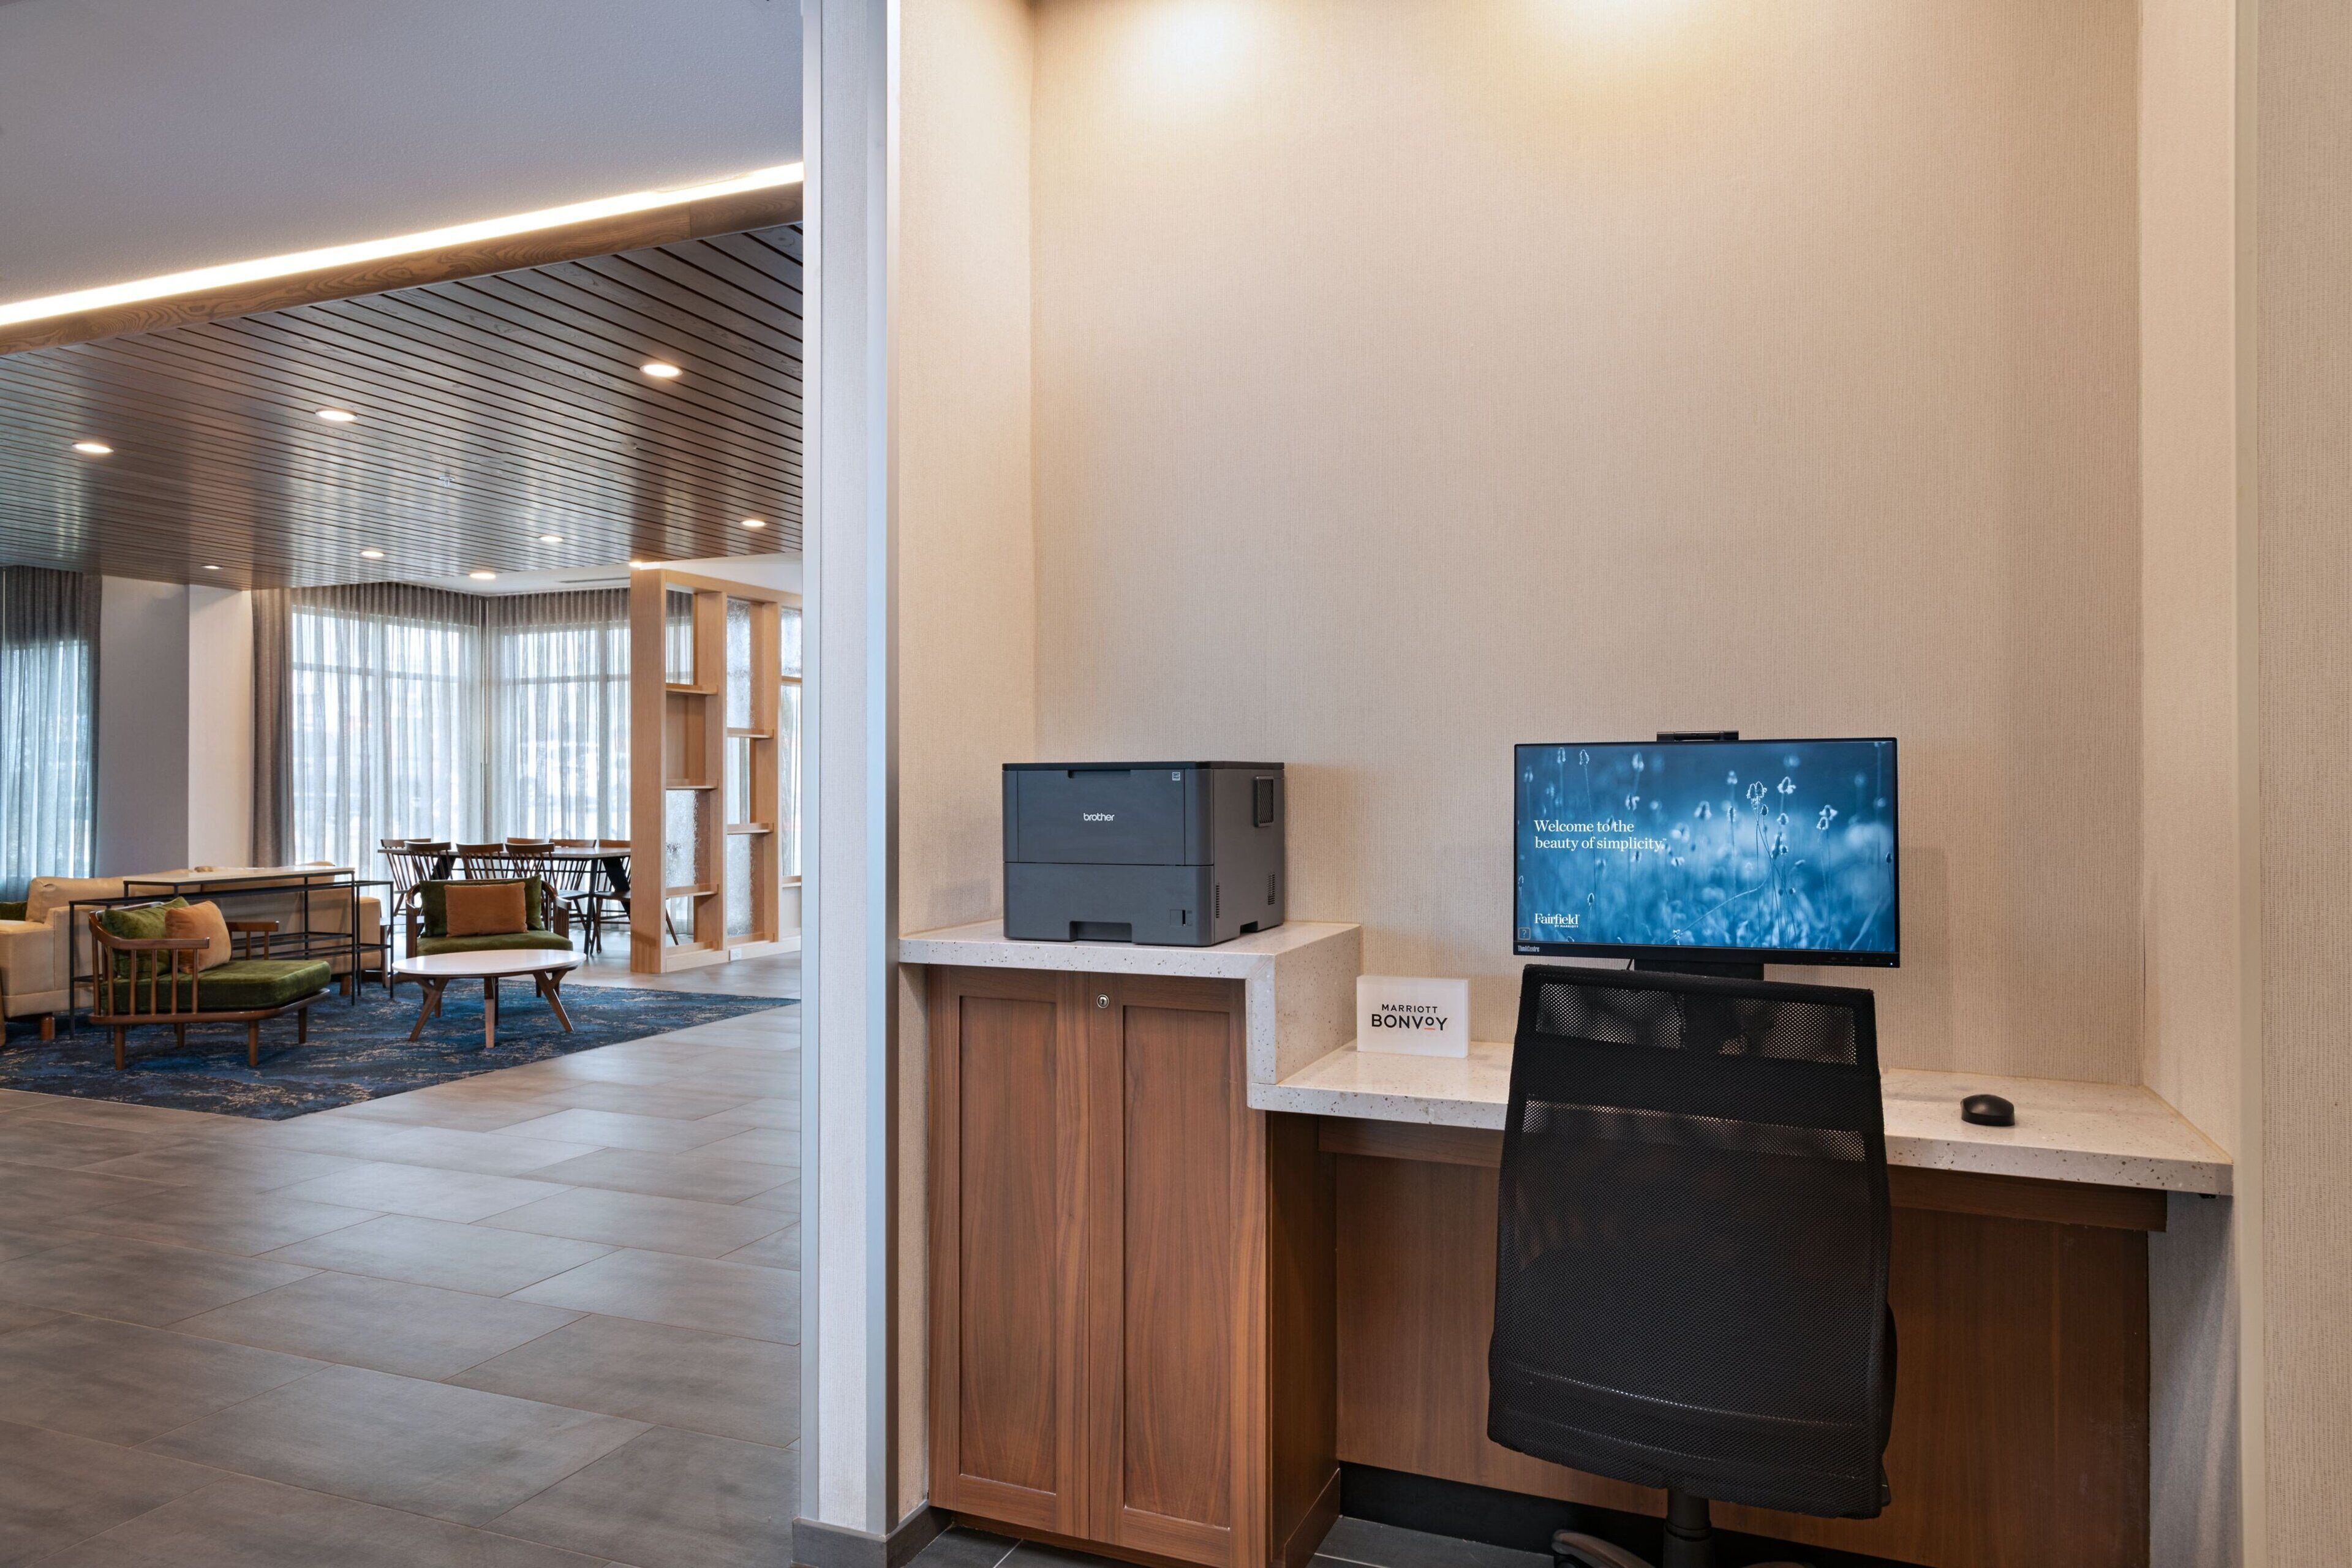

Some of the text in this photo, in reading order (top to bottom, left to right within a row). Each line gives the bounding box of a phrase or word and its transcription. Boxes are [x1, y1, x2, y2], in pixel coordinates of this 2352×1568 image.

[1083, 812, 1115, 821] brother
[1534, 820, 1635, 833] Welcome to the
[1535, 836, 1578, 851] beauty
[1581, 836, 1596, 850] of
[1534, 913, 1578, 925] Fairfield
[1382, 1004, 1438, 1013] MARRIOTT
[1371, 1014, 1448, 1031] BONVOY
